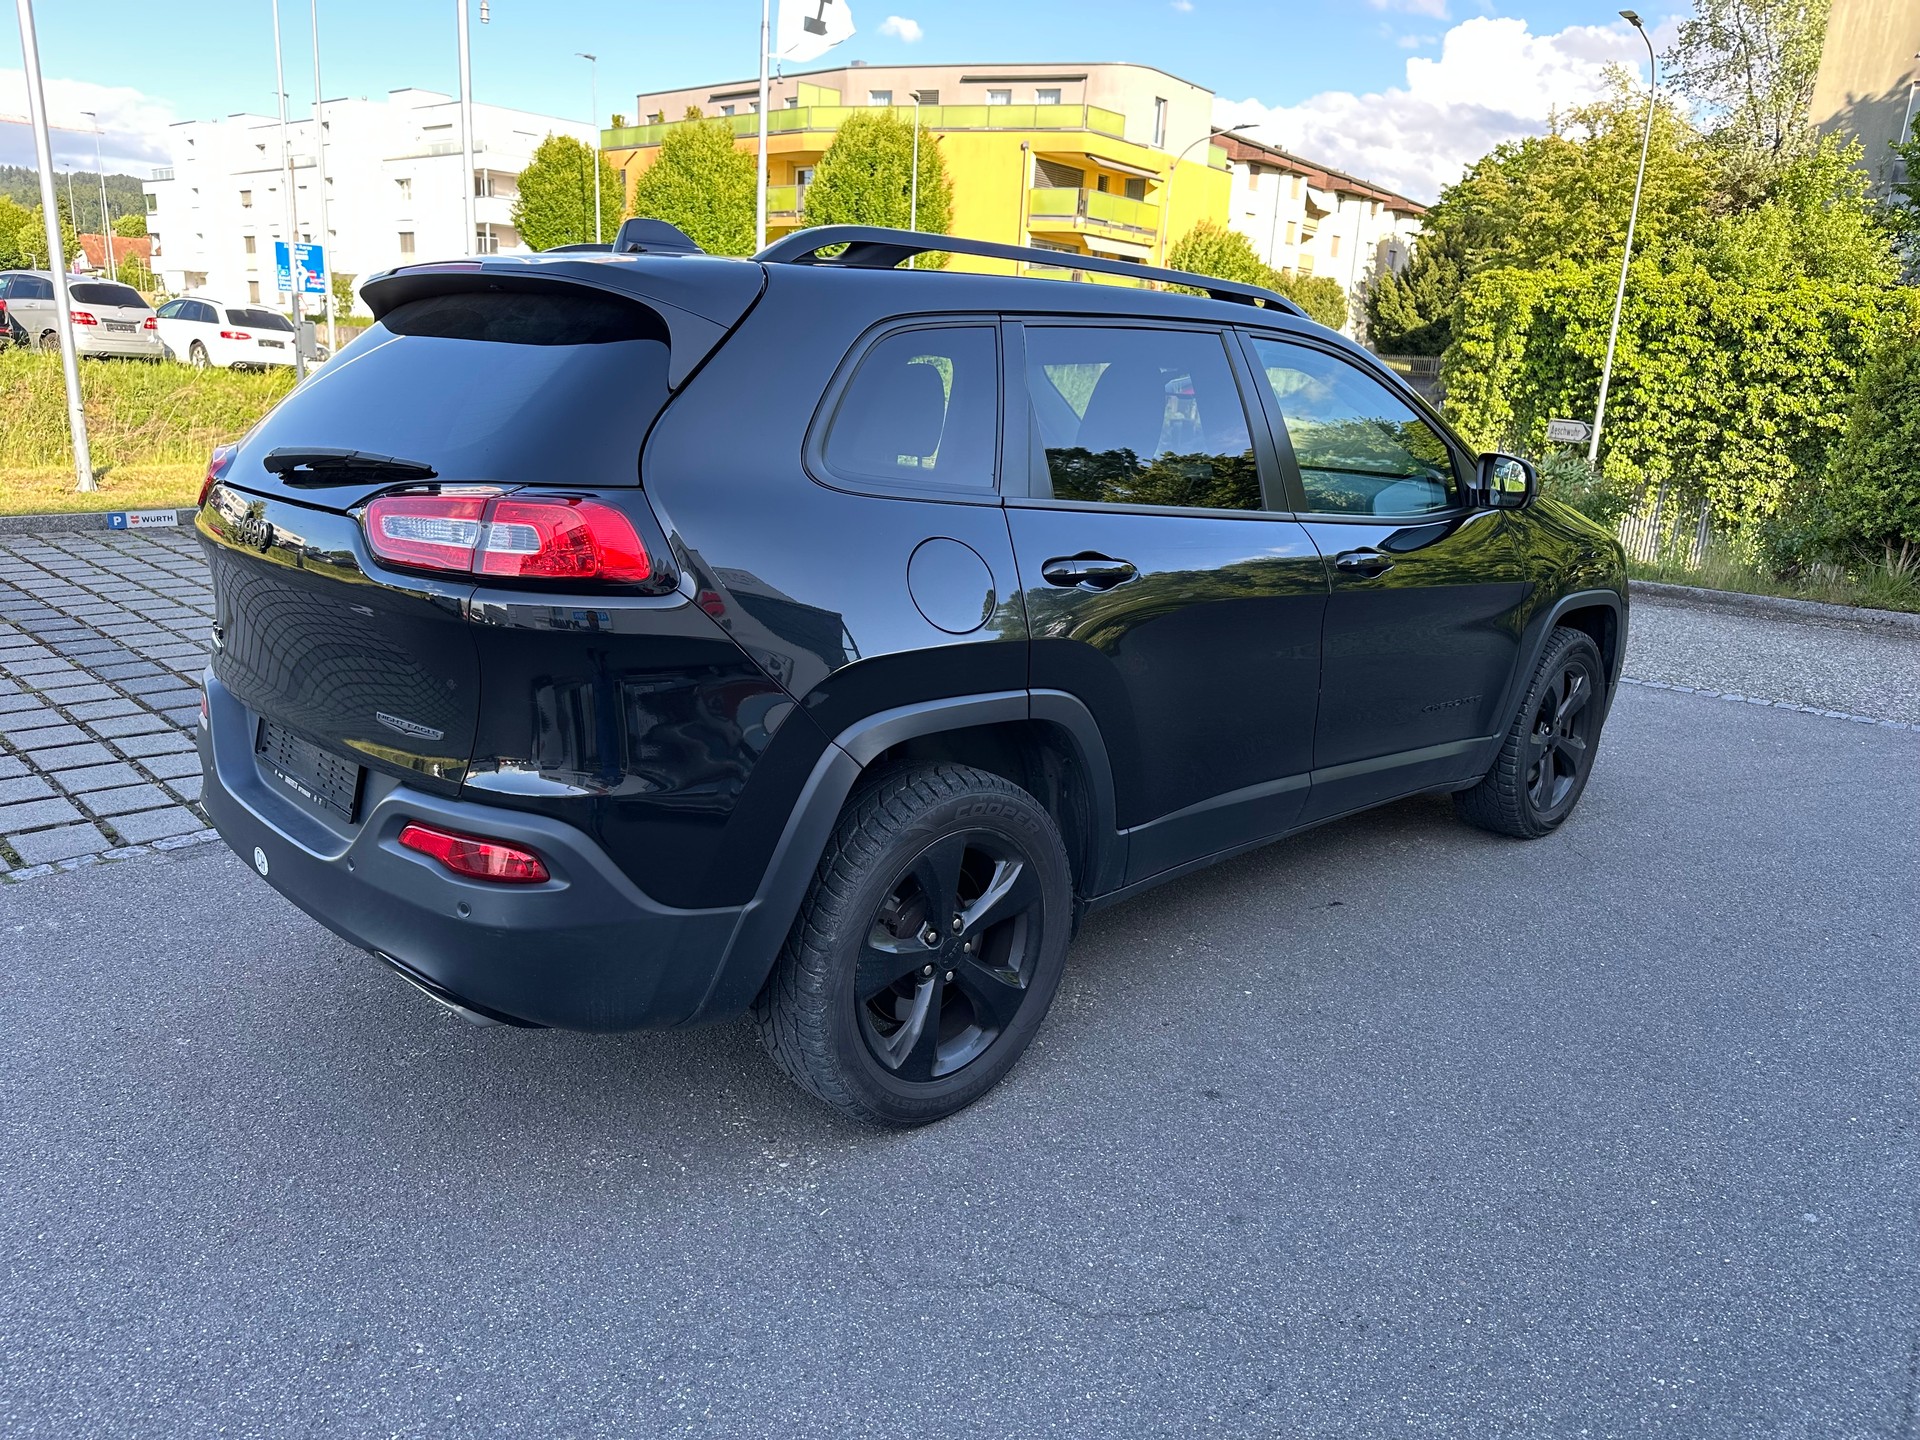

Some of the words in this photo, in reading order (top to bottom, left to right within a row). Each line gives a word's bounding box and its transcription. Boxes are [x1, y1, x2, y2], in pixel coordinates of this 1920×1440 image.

[113, 516, 122, 526] P
[235, 510, 274, 553] Jeep
[377, 713, 406, 726] NIGHT
[407, 723, 440, 738] EAGLE
[955, 802, 1041, 834] COOPER
